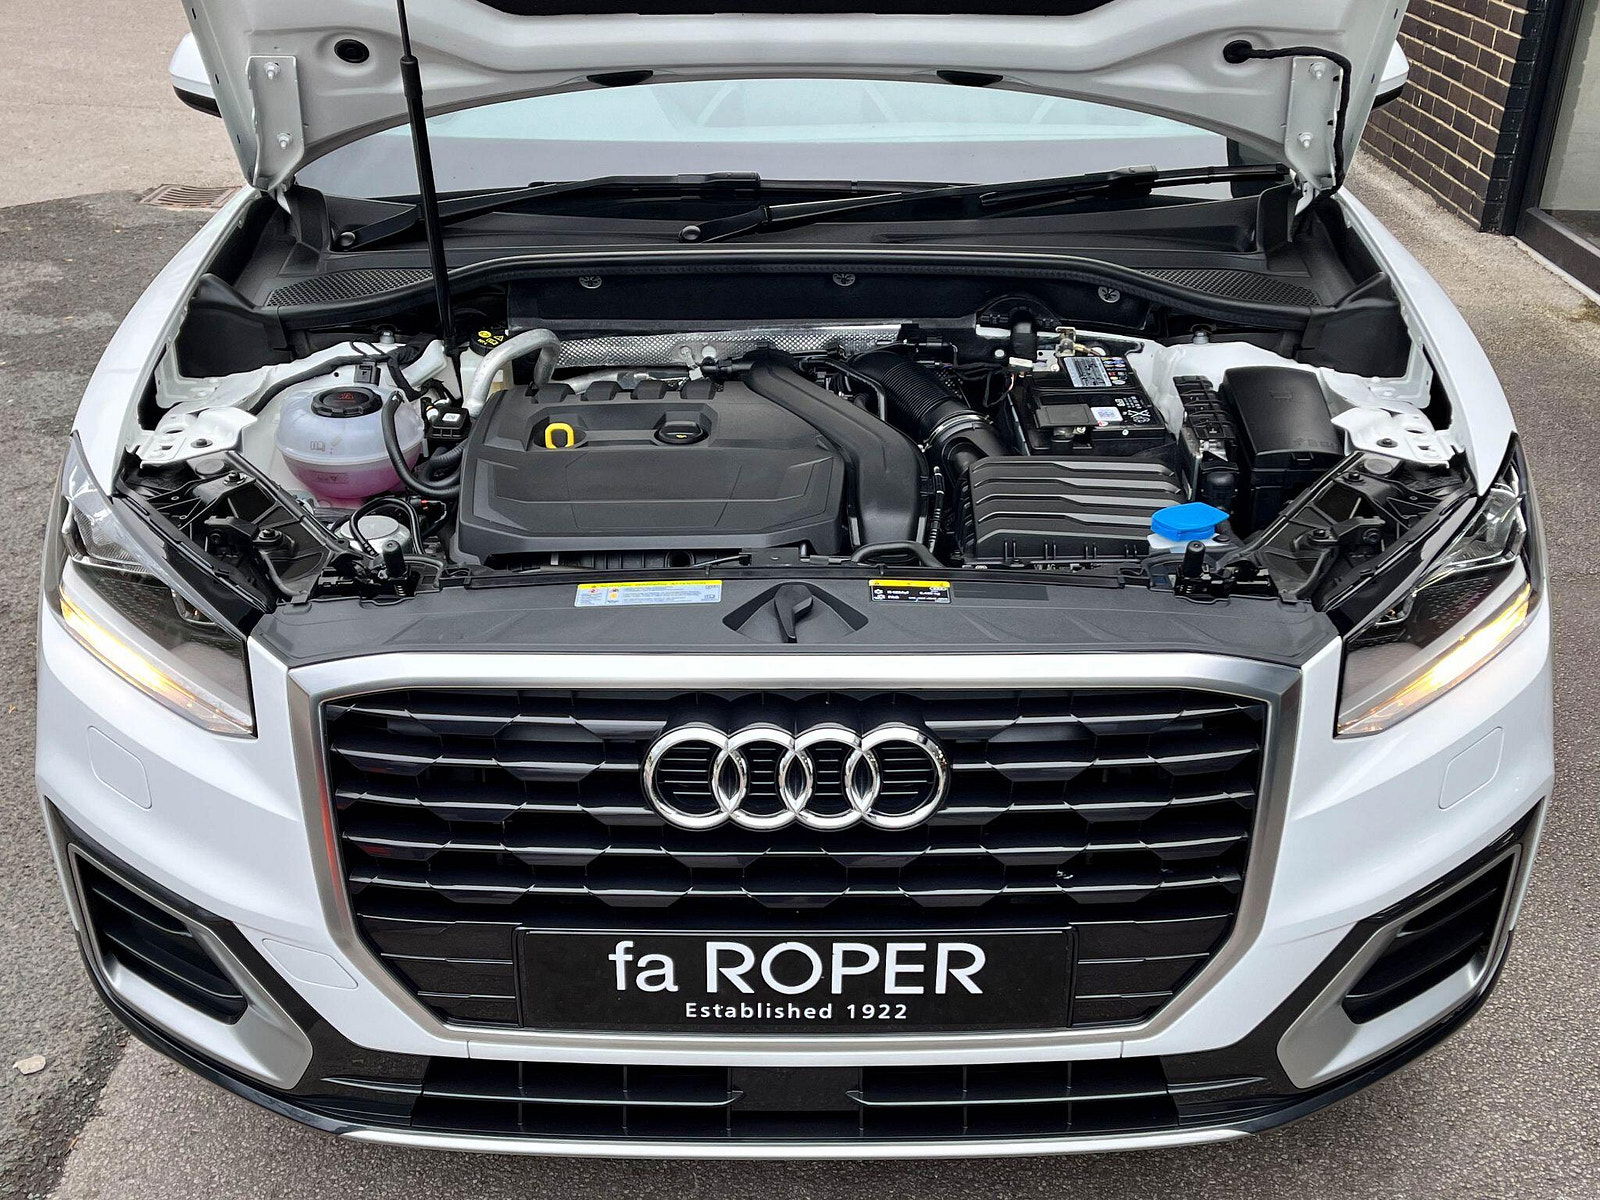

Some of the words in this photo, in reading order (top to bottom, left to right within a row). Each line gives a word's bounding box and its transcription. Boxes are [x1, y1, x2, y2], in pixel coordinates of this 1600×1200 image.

[608, 940, 679, 993] fa
[706, 941, 986, 995] ROPER
[685, 1002, 833, 1019] Established
[846, 1003, 907, 1020] 1922
